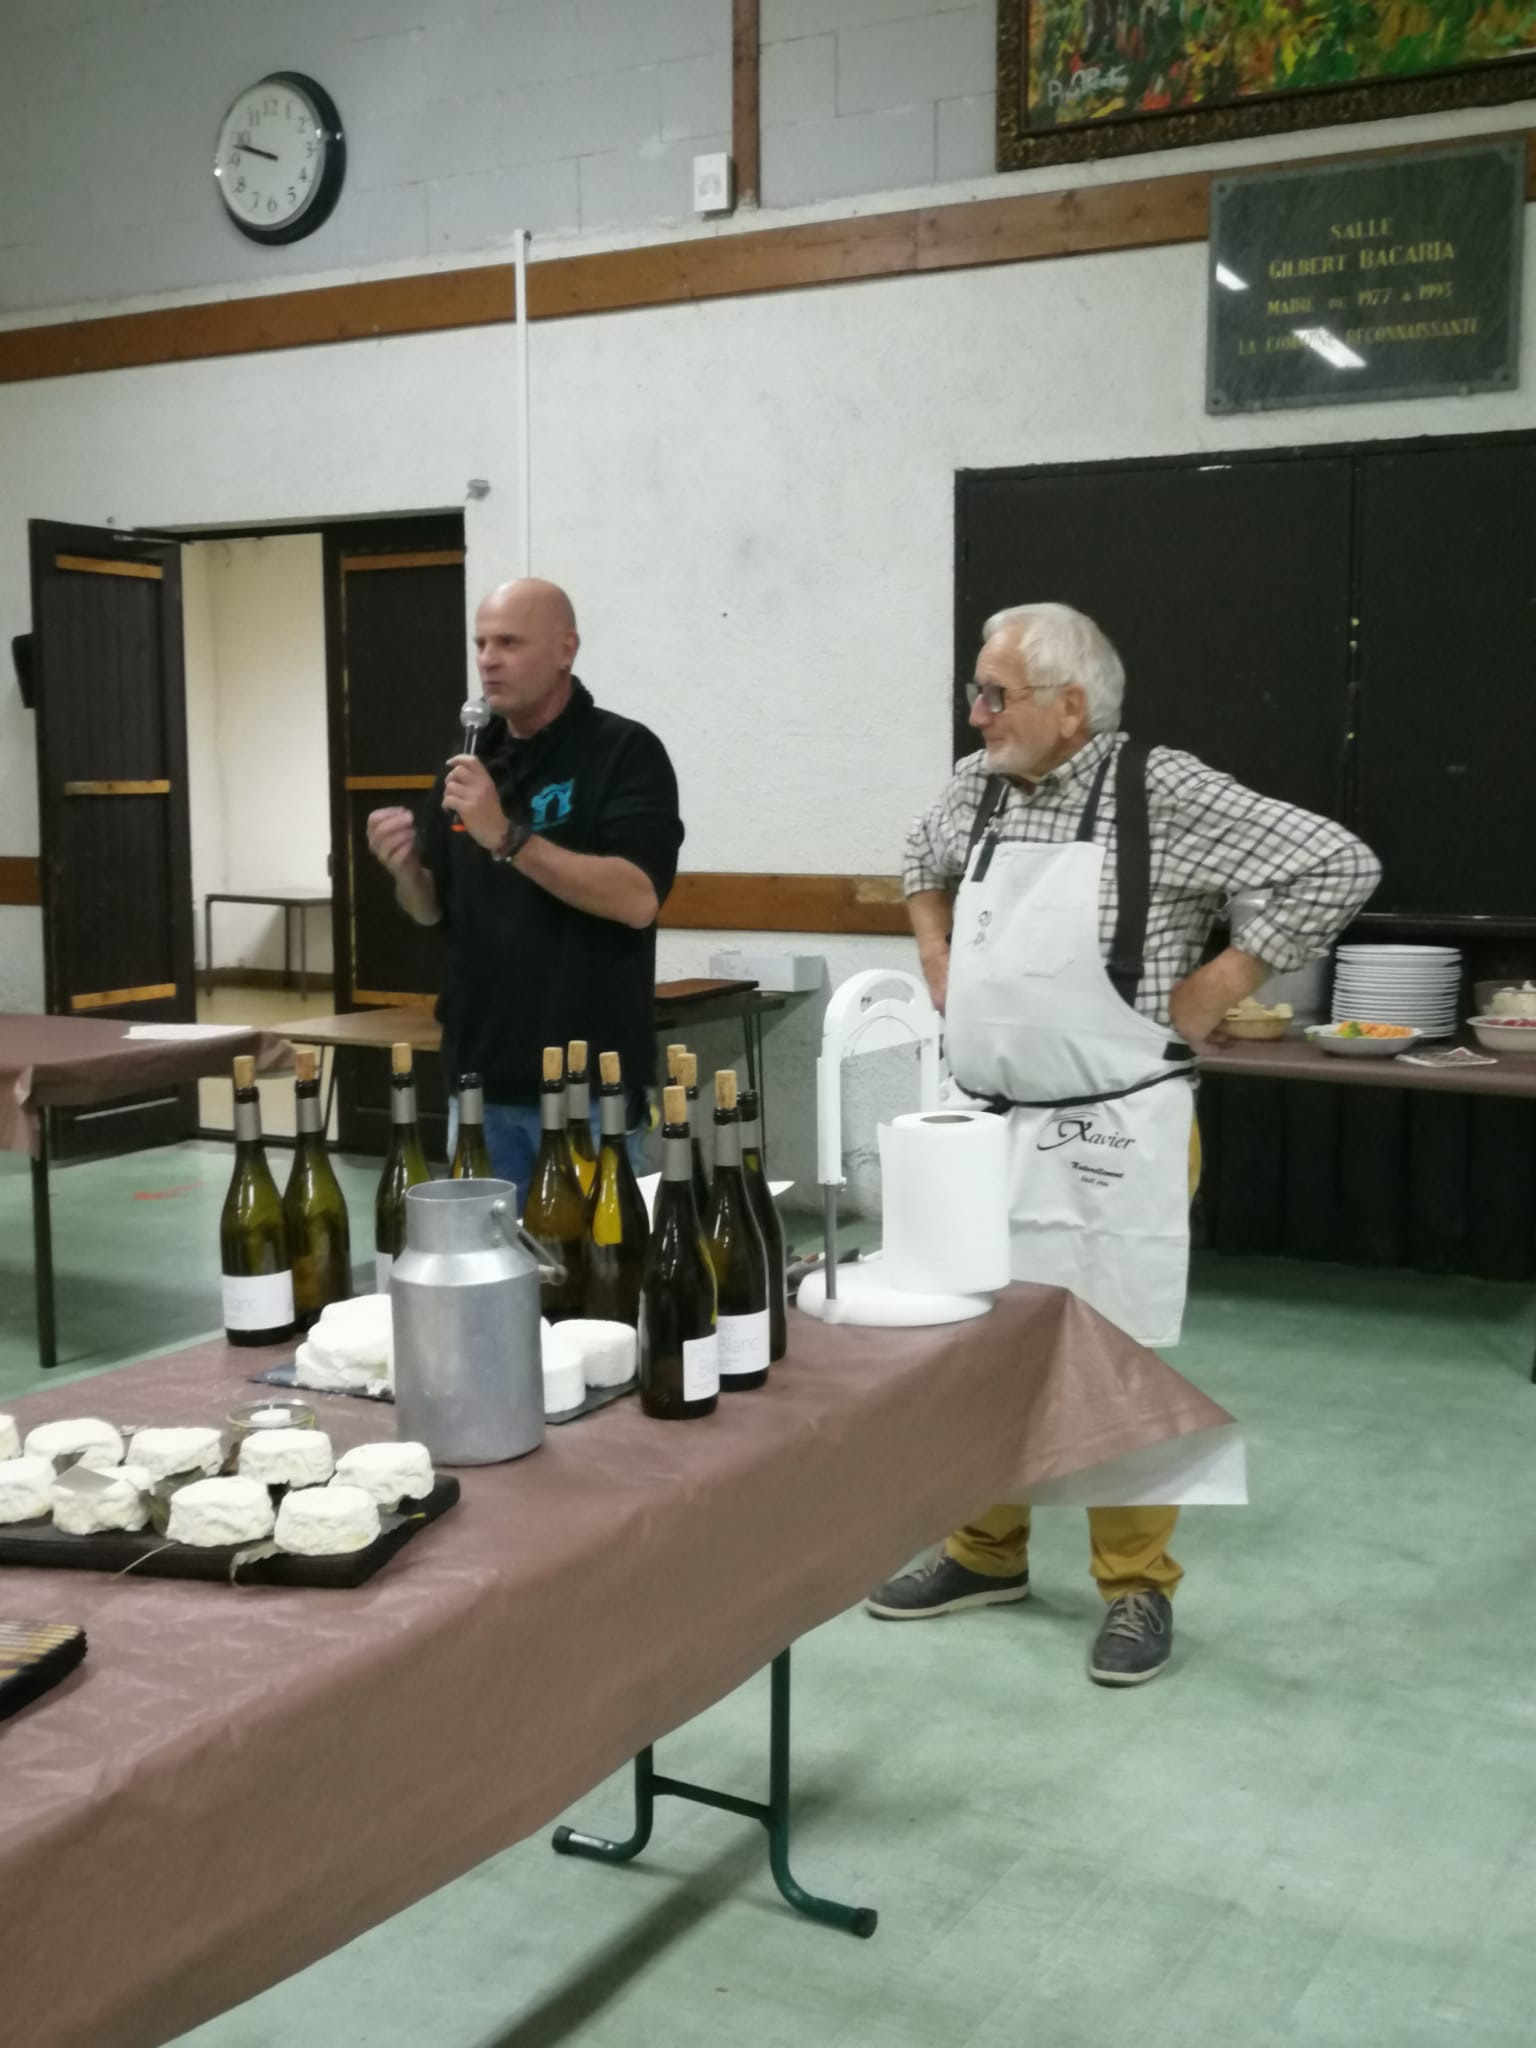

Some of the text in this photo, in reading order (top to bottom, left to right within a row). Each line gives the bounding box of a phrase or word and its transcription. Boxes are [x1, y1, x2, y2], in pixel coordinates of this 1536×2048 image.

[249, 105, 260, 127] 11
[264, 98, 278, 116] 12
[285, 103, 291, 120] 1
[297, 116, 306, 133] 2
[305, 141, 314, 159] 3
[229, 152, 241, 168] 9
[234, 176, 246, 193] 8
[298, 168, 307, 183] 4
[252, 192, 260, 210] 7
[267, 195, 278, 213] 6
[287, 187, 297, 206] 5
[1330, 217, 1392, 240] SALLE
[1268, 240, 1455, 279] GILBERT BACARIA
[1266, 296, 1314, 316] MAIRE
[1238, 337, 1257, 355] LA
[1037, 1120, 1136, 1151] Xavier
